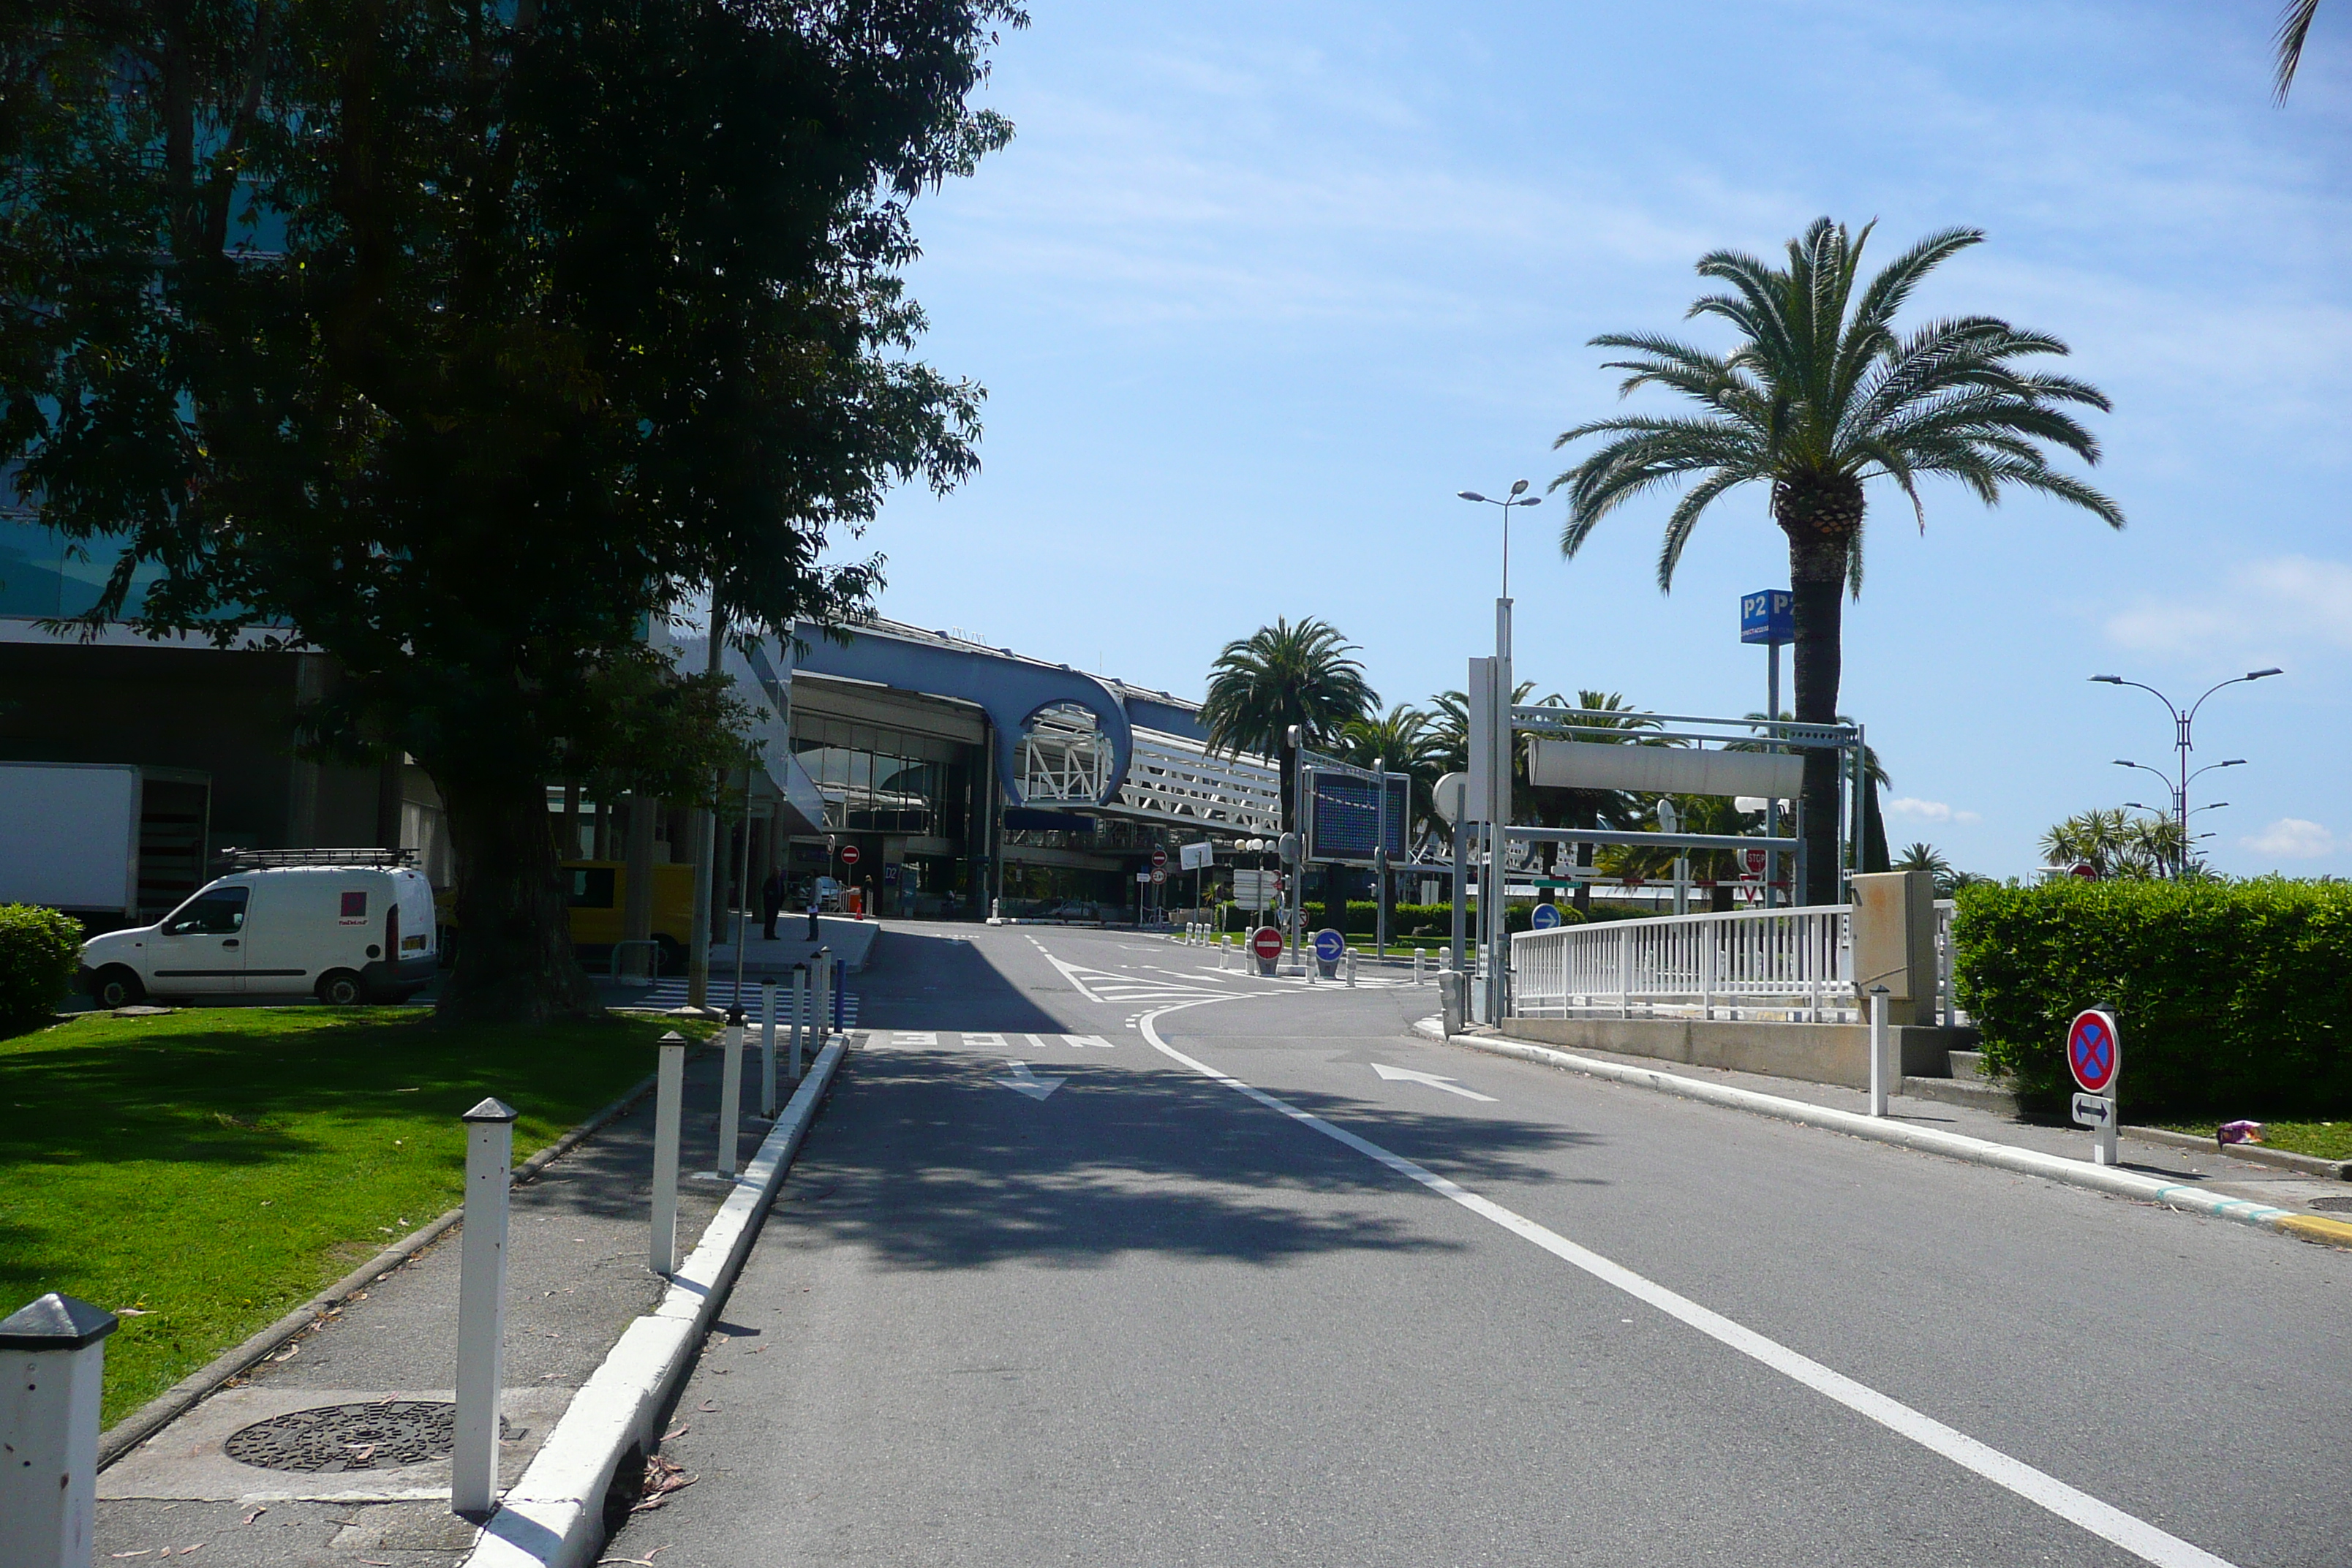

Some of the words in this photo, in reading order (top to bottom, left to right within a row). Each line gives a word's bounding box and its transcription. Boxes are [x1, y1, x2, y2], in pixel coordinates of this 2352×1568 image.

[1744, 595, 1766, 619] P2
[1748, 853, 1765, 863] STOP
[886, 867, 897, 879] D2
